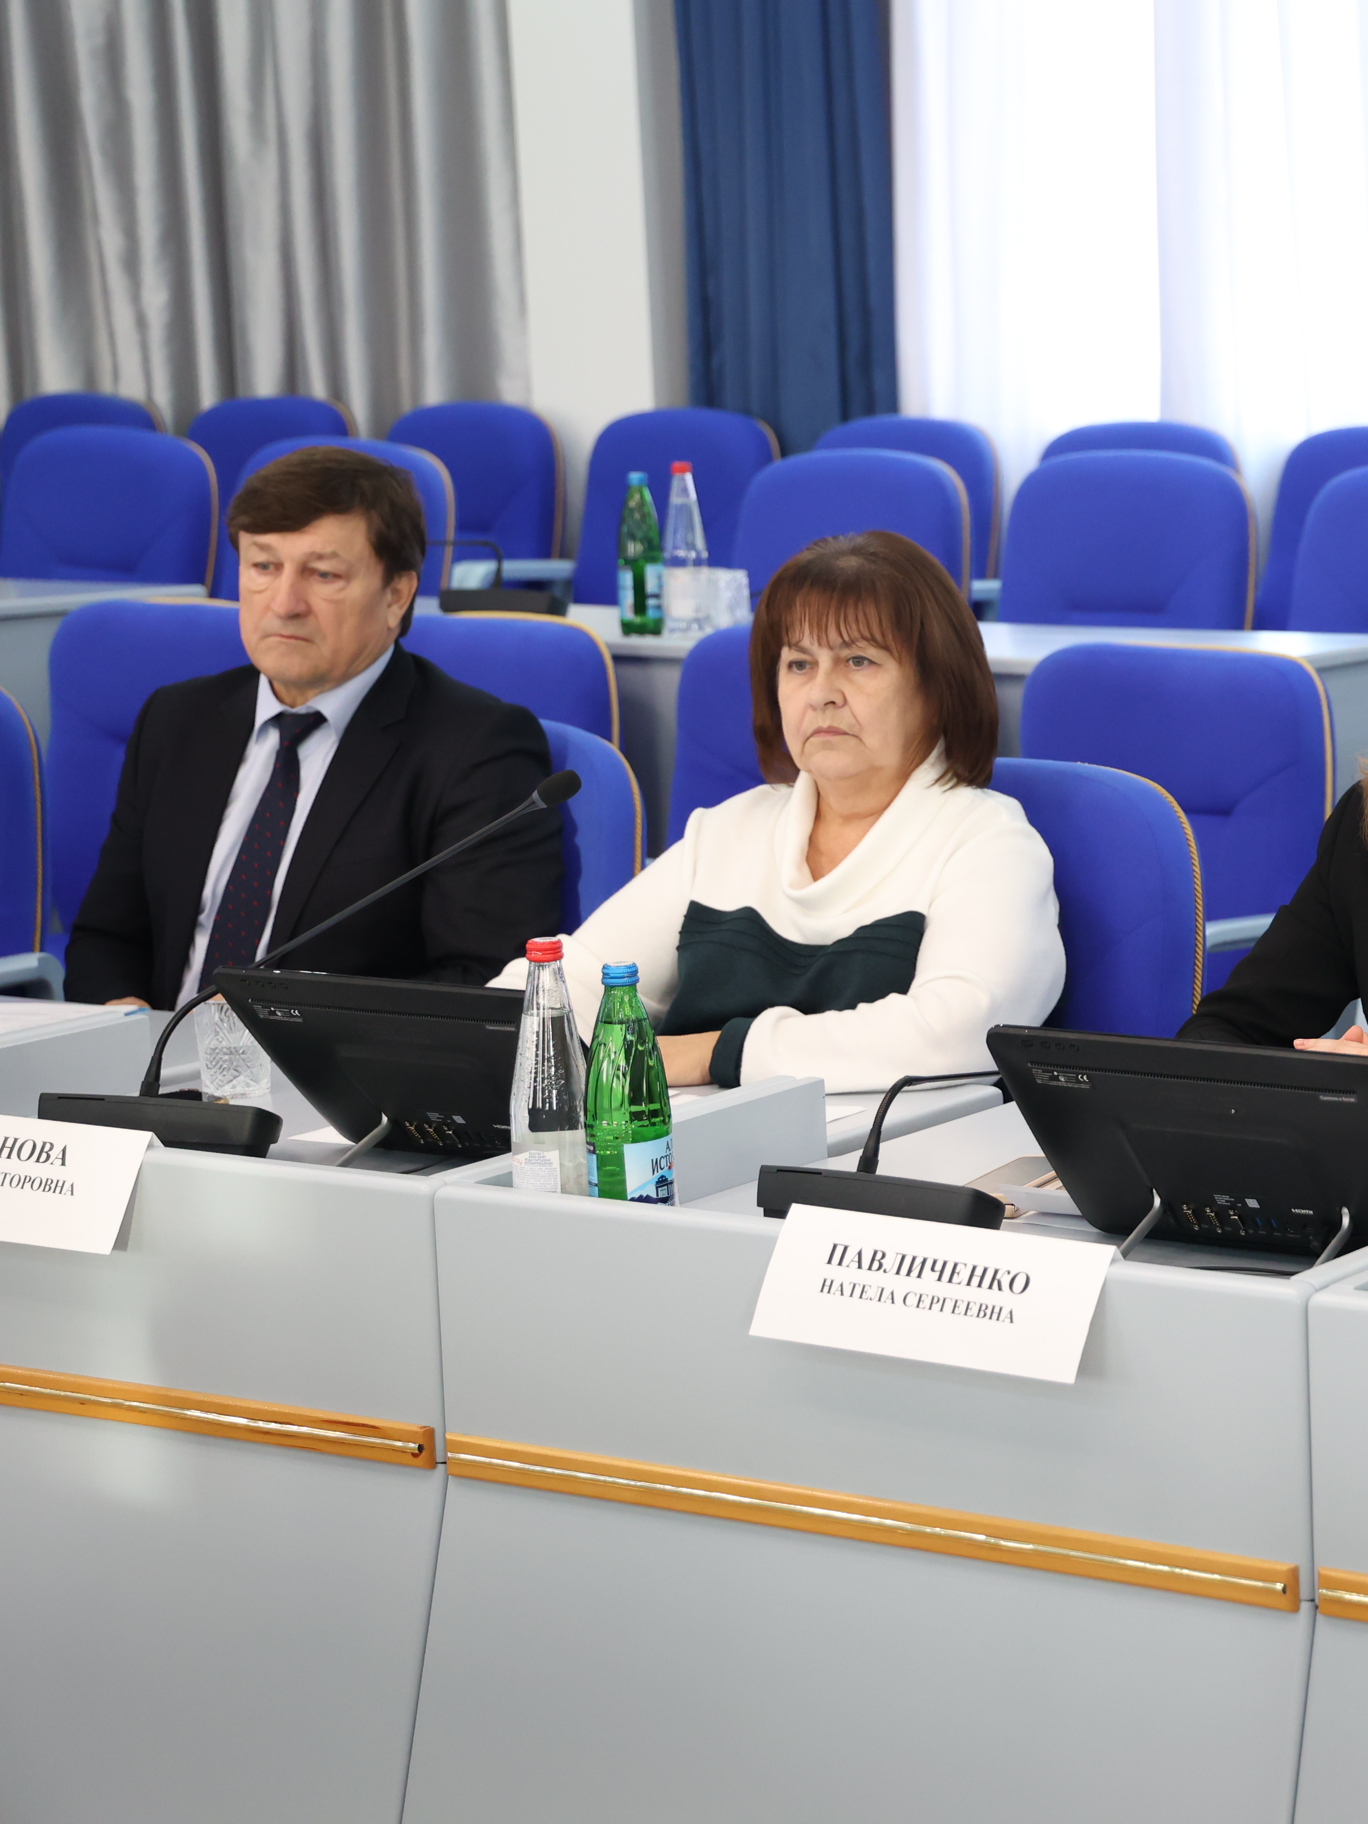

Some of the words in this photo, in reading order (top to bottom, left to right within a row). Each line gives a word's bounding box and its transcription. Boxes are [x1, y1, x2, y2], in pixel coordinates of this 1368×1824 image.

[0, 1136, 68, 1167] НОВА
[0, 1171, 75, 1197] ТОРОВНА
[825, 1242, 1031, 1295] ПАВЛИЧЕНКО
[819, 1278, 896, 1305] НАТЕЛА
[902, 1291, 1014, 1324] СЕРГЕЕВНА
